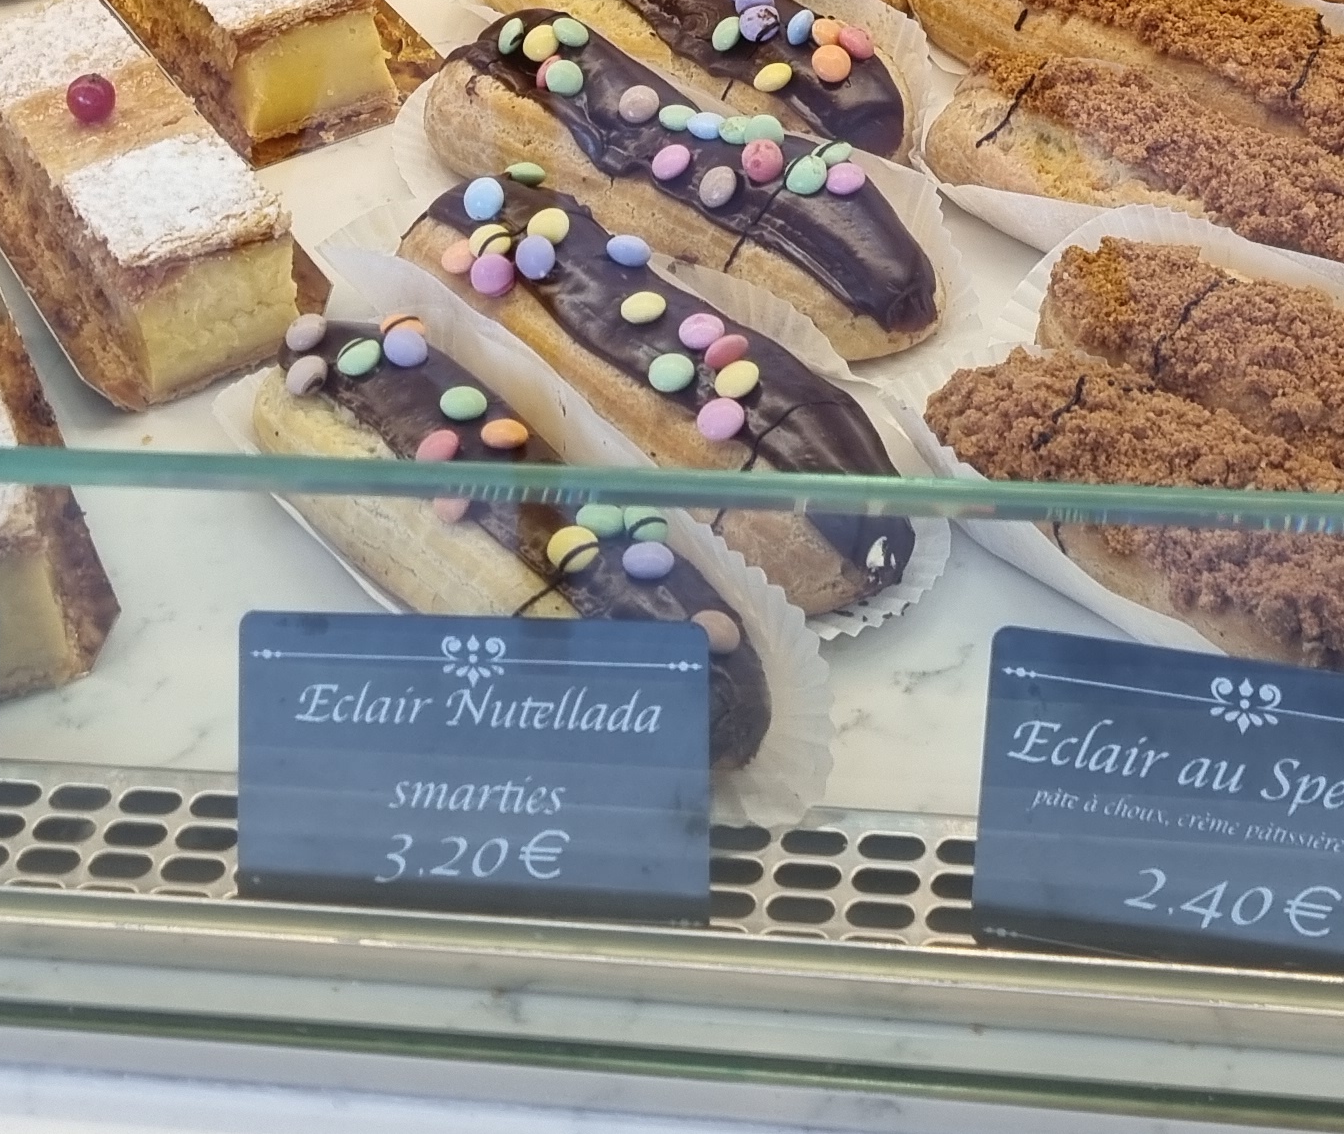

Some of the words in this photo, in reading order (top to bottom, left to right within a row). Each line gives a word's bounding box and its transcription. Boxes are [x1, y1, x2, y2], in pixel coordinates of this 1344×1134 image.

[294, 680, 433, 724] Eclair
[445, 683, 662, 734] Nutellada
[1007, 719, 1170, 778] Eclair
[1177, 757, 1247, 794] au
[388, 775, 566, 816] smarties
[1083, 793, 1099, 813] à
[1104, 794, 1170, 827] choux,
[1178, 812, 1240, 836] crème
[374, 829, 571, 883] 3.20€
[1123, 867, 1342, 937] 2.40€
